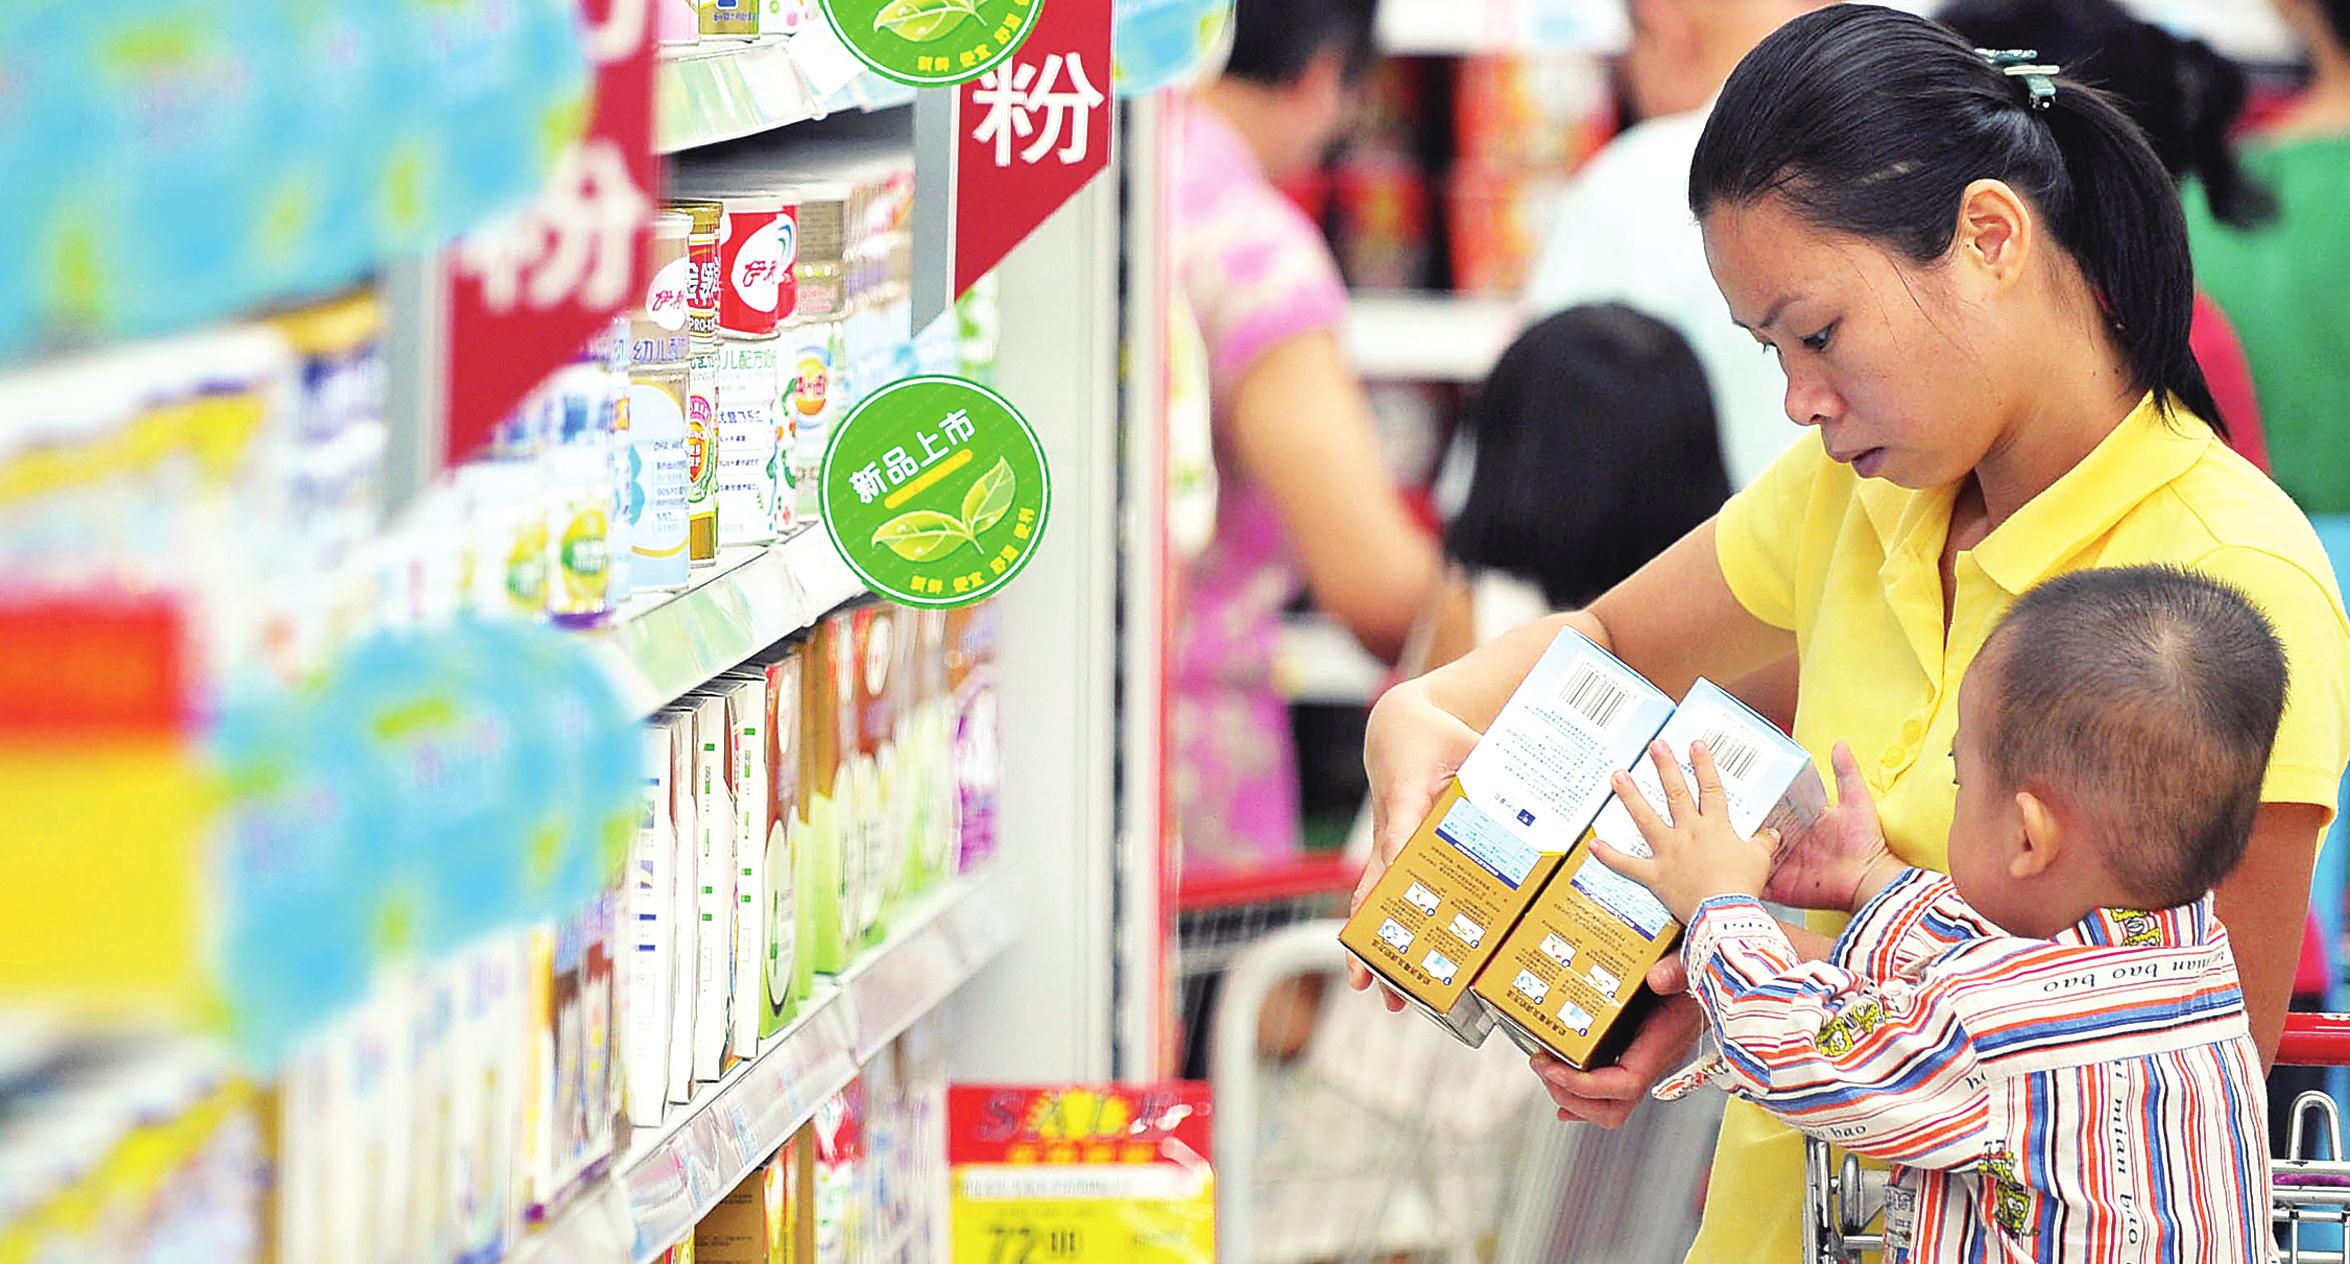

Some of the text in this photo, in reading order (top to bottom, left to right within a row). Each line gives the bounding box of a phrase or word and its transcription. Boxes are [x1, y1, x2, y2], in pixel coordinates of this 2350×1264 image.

[973, 52, 1105, 167] 粉
[849, 408, 976, 504] 新品上市
[2043, 973, 2096, 993] bao
[2112, 963, 2158, 979] bao
[2113, 1098, 2127, 1174] mian
